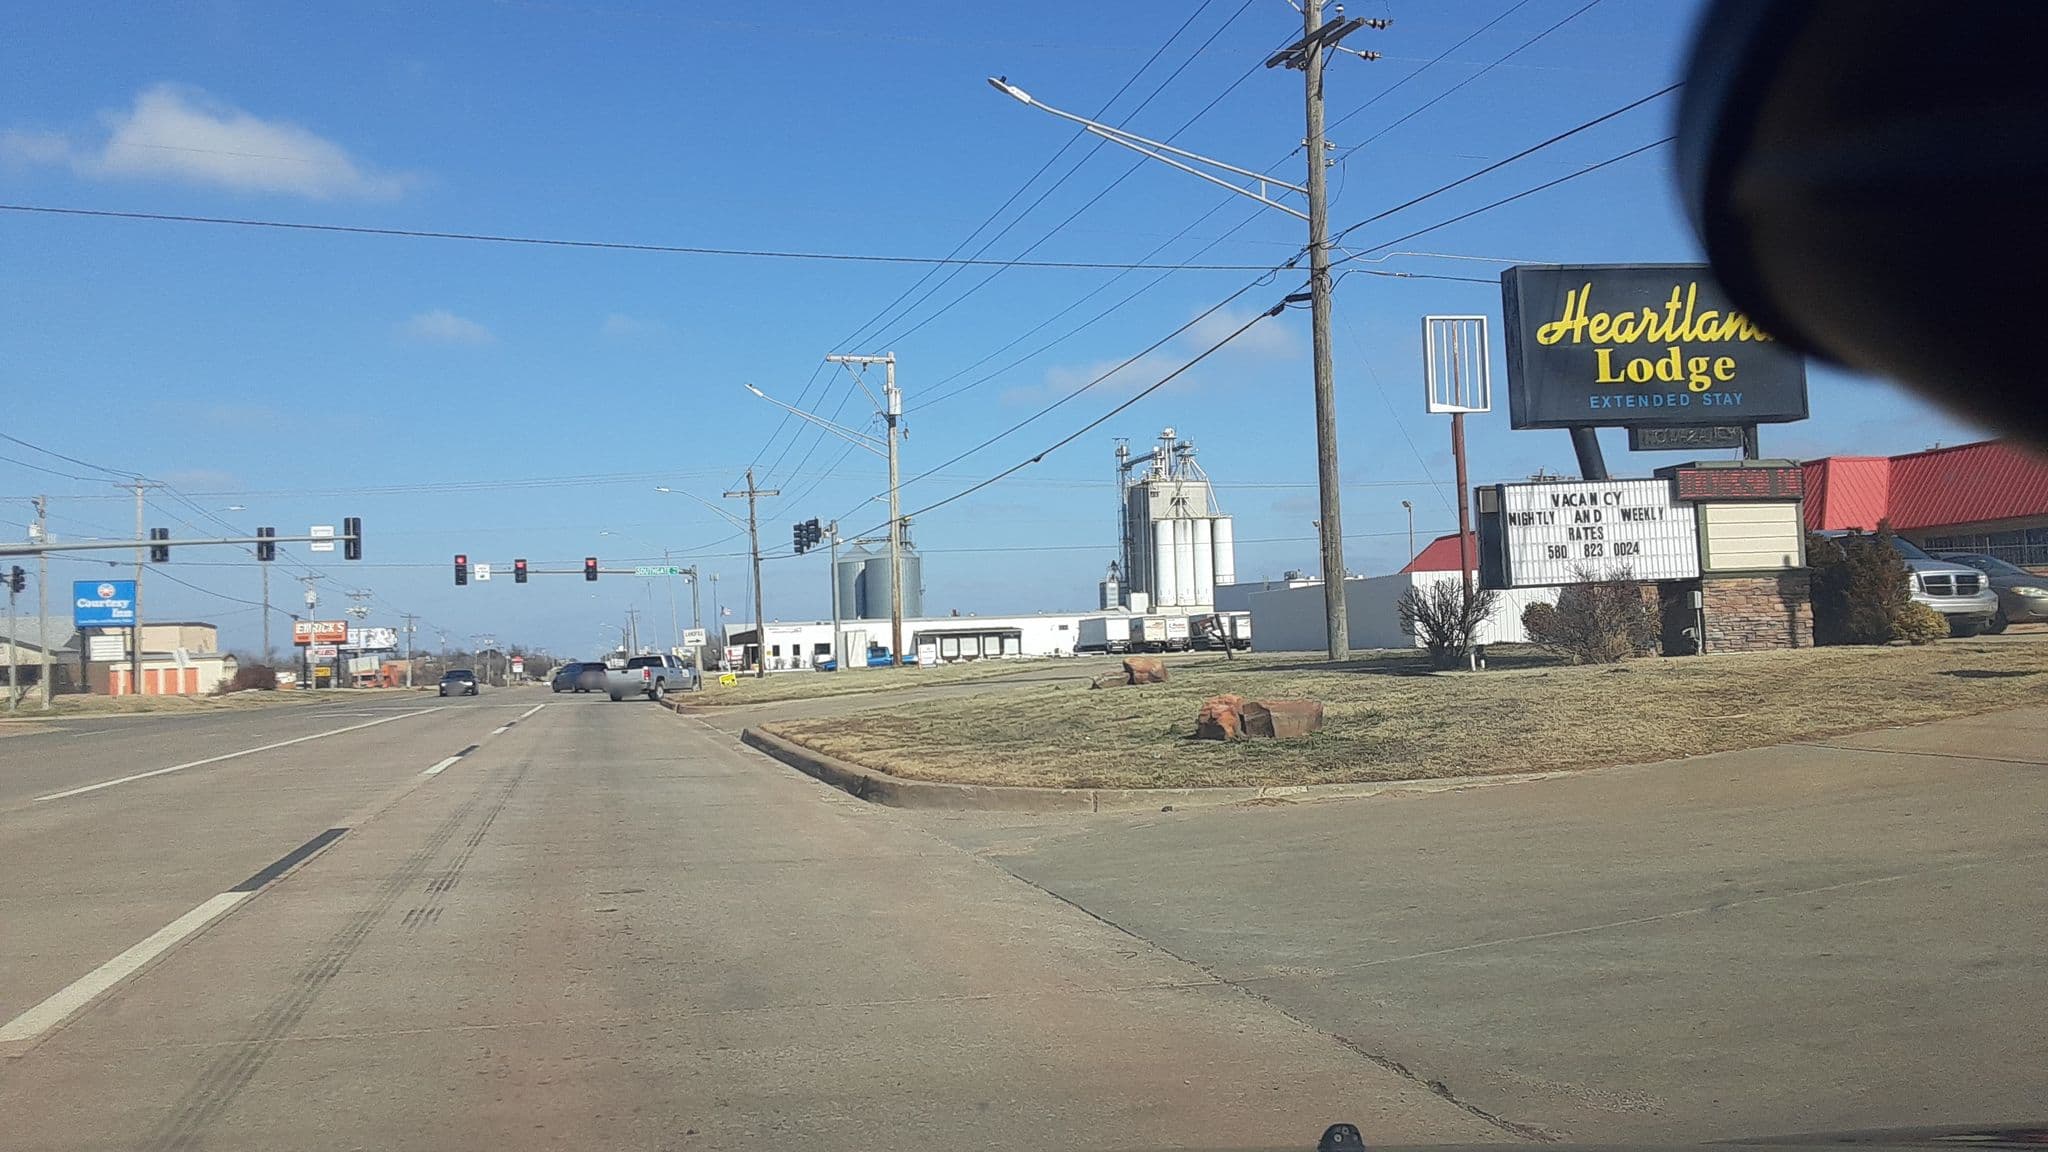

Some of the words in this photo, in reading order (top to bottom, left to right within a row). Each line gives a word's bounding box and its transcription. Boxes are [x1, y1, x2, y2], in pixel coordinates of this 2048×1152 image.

[1536, 281, 1774, 345] Heartlan
[1594, 346, 1737, 392] Lodge
[1589, 393, 1690, 408] EXTENDED
[1703, 392, 1743, 406] STAY
[1551, 491, 1622, 507] VACANCY
[1508, 510, 1555, 526] NIGHTLY
[1574, 509, 1602, 523] AND
[1621, 506, 1664, 521] WEEKLY
[1568, 526, 1604, 541] RATES
[1547, 545, 1568, 559] 580
[1584, 543, 1603, 557] 823
[1613, 541, 1640, 556] 0024
